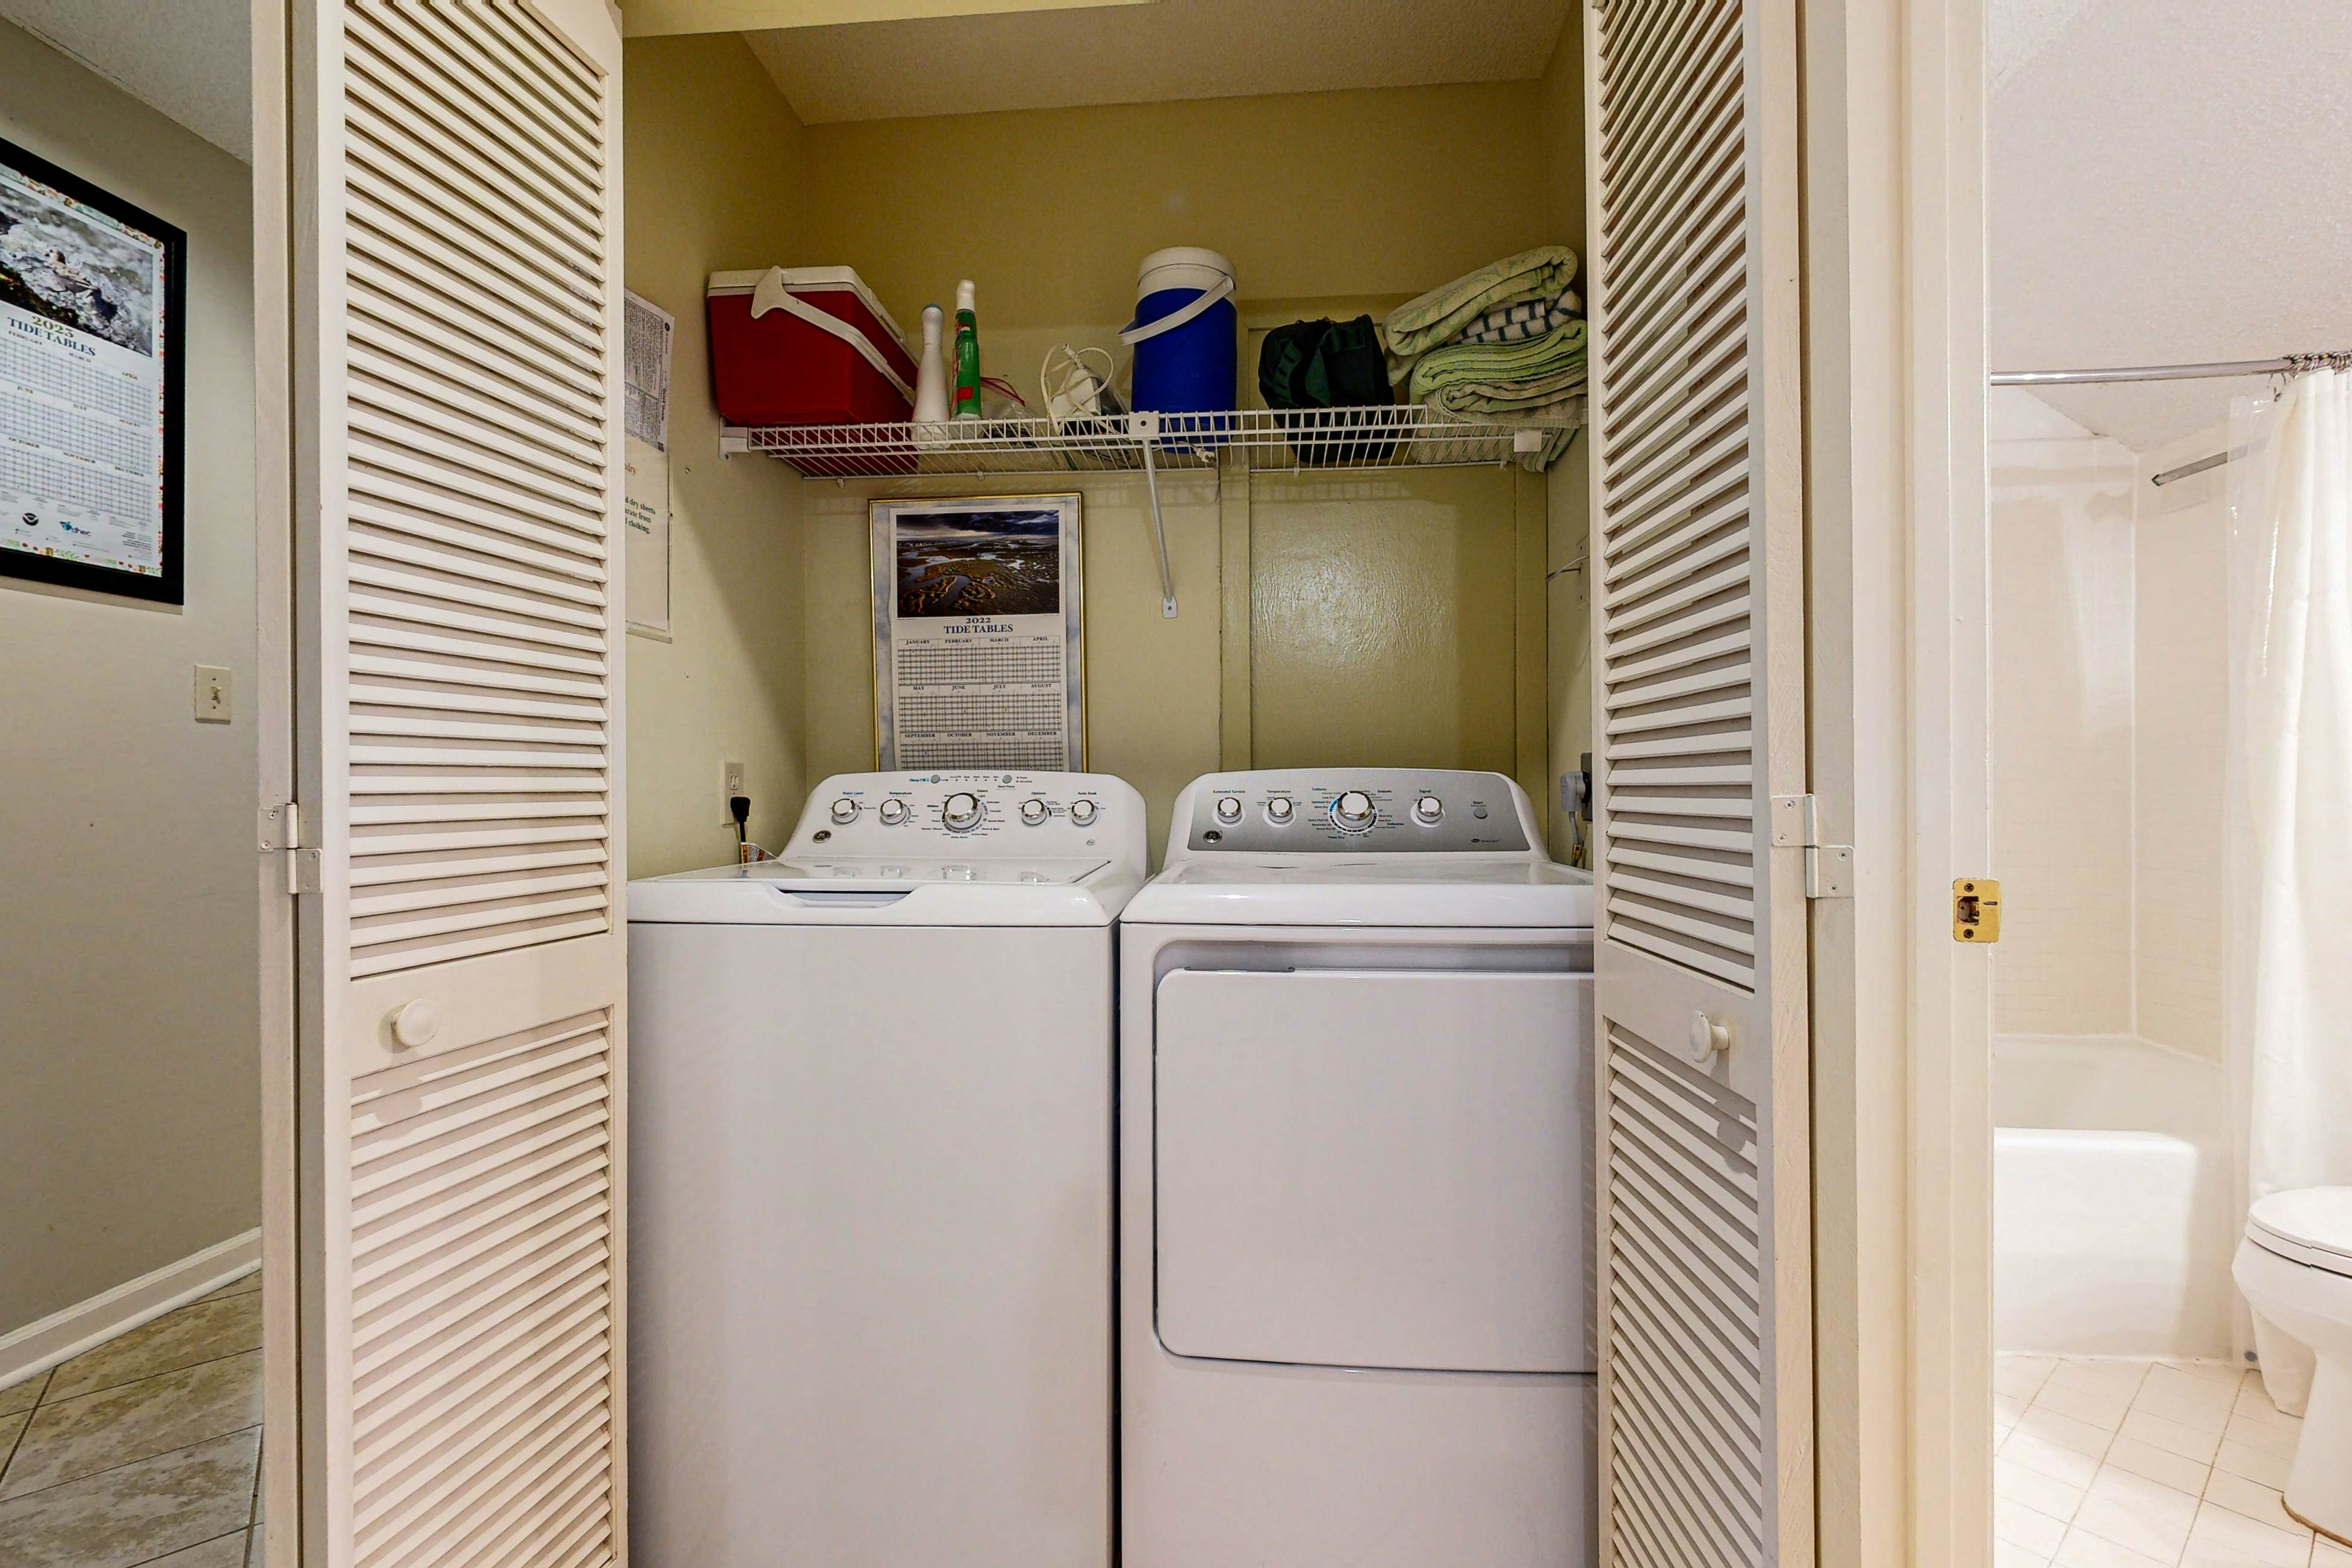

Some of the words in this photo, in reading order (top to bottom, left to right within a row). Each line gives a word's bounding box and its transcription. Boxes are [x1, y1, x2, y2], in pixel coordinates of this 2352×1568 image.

[32, 316, 74, 338] 2025
[7, 317, 42, 338] TIDE
[43, 331, 96, 356] TABLES
[63, 452, 96, 464] NOVEMBER
[114, 466, 145, 477] DECEMBER
[630, 498, 638, 509] dry
[640, 503, 656, 515] sheets
[639, 512, 651, 523] from
[629, 520, 650, 535] clothing.
[944, 625, 971, 634] TIDE
[972, 624, 1013, 633] TABLES
